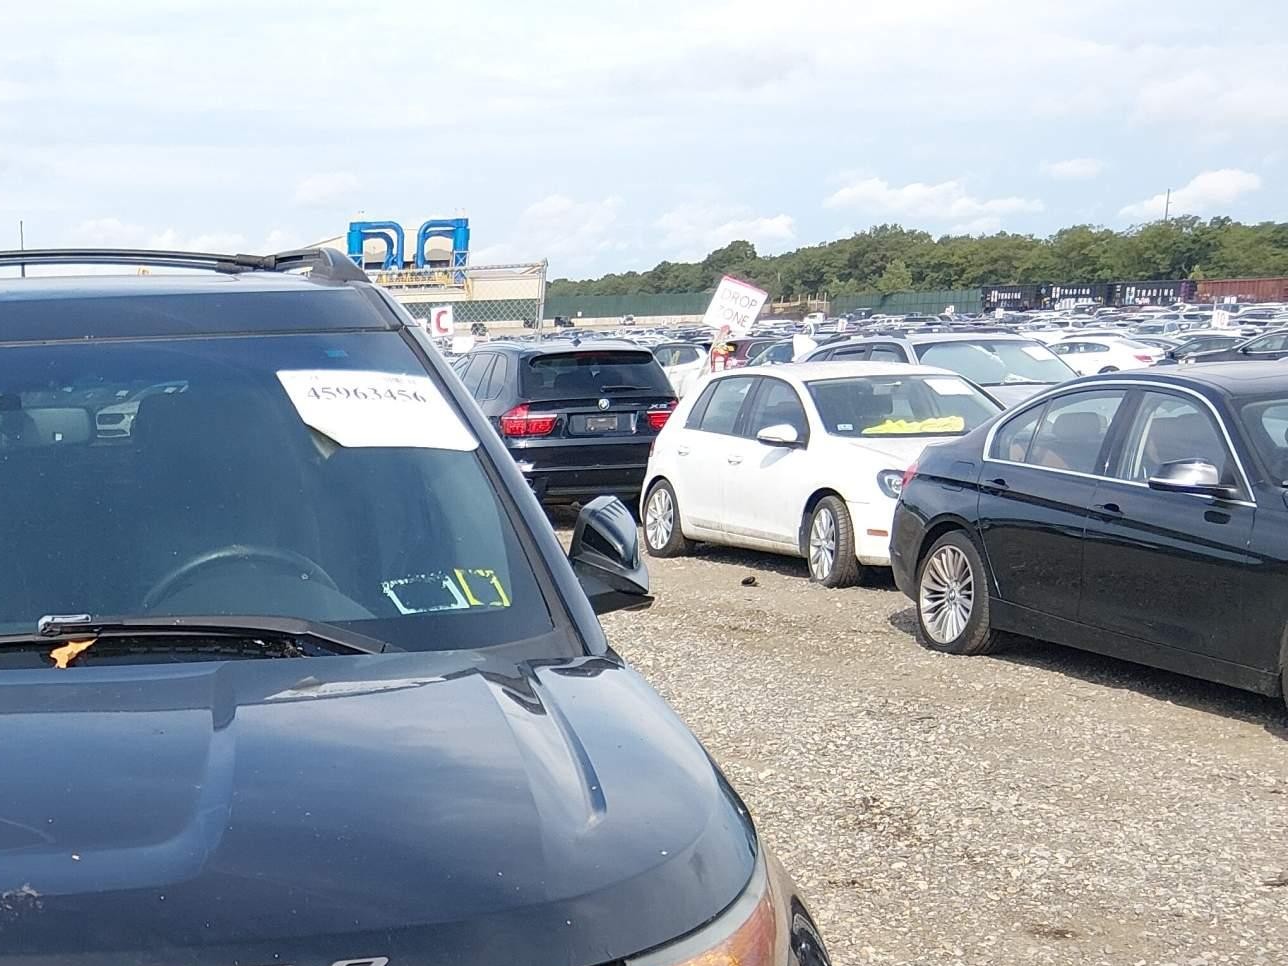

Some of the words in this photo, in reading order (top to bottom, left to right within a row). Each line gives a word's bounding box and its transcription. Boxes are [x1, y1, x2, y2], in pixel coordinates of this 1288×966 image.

[720, 288, 758, 311] DROP
[436, 310, 449, 334] C
[307, 386, 427, 404] 45963456
